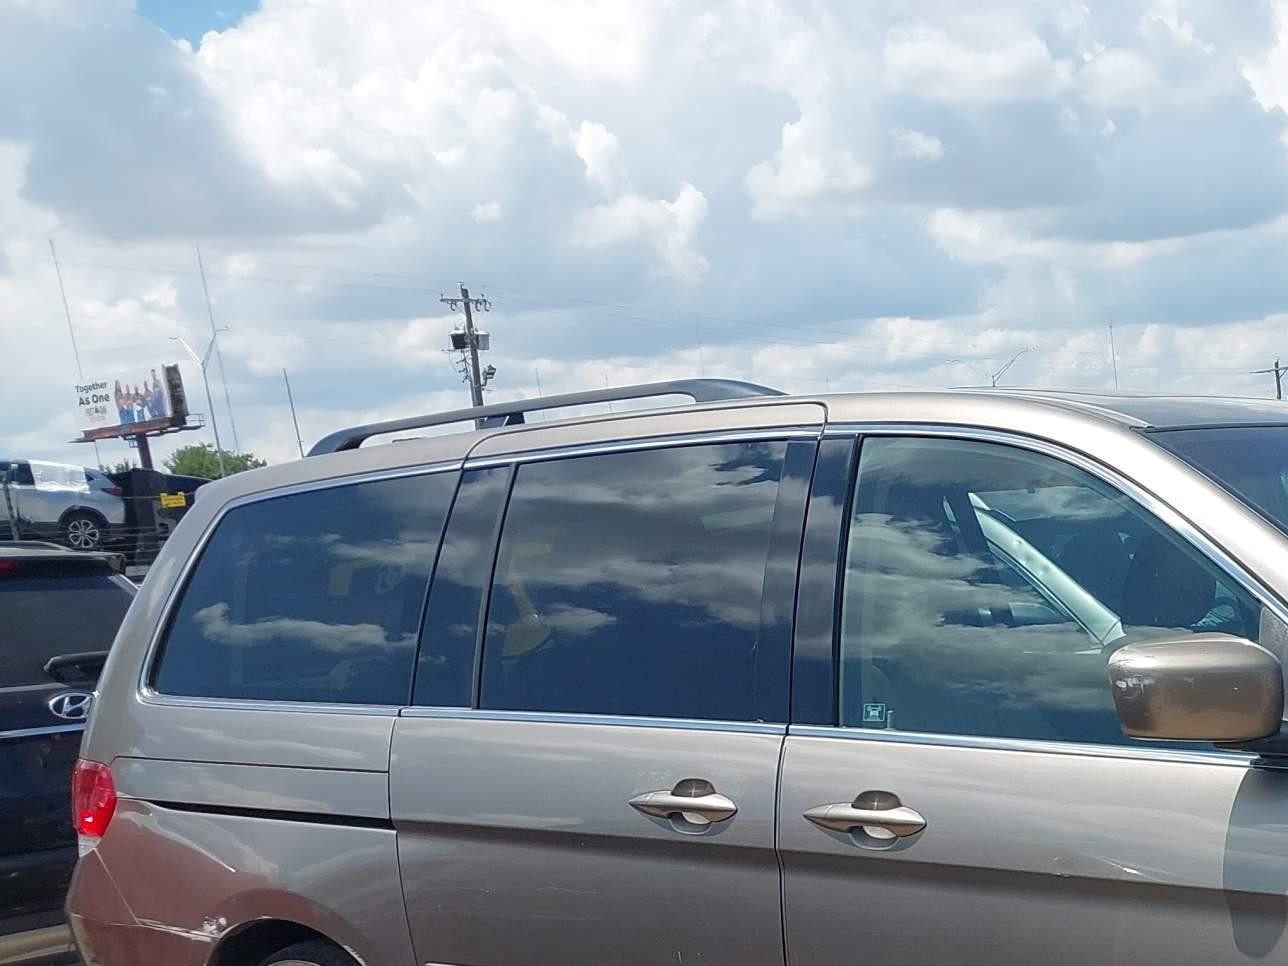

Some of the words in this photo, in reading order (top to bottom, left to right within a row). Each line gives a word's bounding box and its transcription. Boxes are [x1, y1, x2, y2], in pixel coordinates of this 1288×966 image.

[75, 382, 108, 394] Together
[79, 396, 91, 407] As
[91, 393, 110, 404] One
